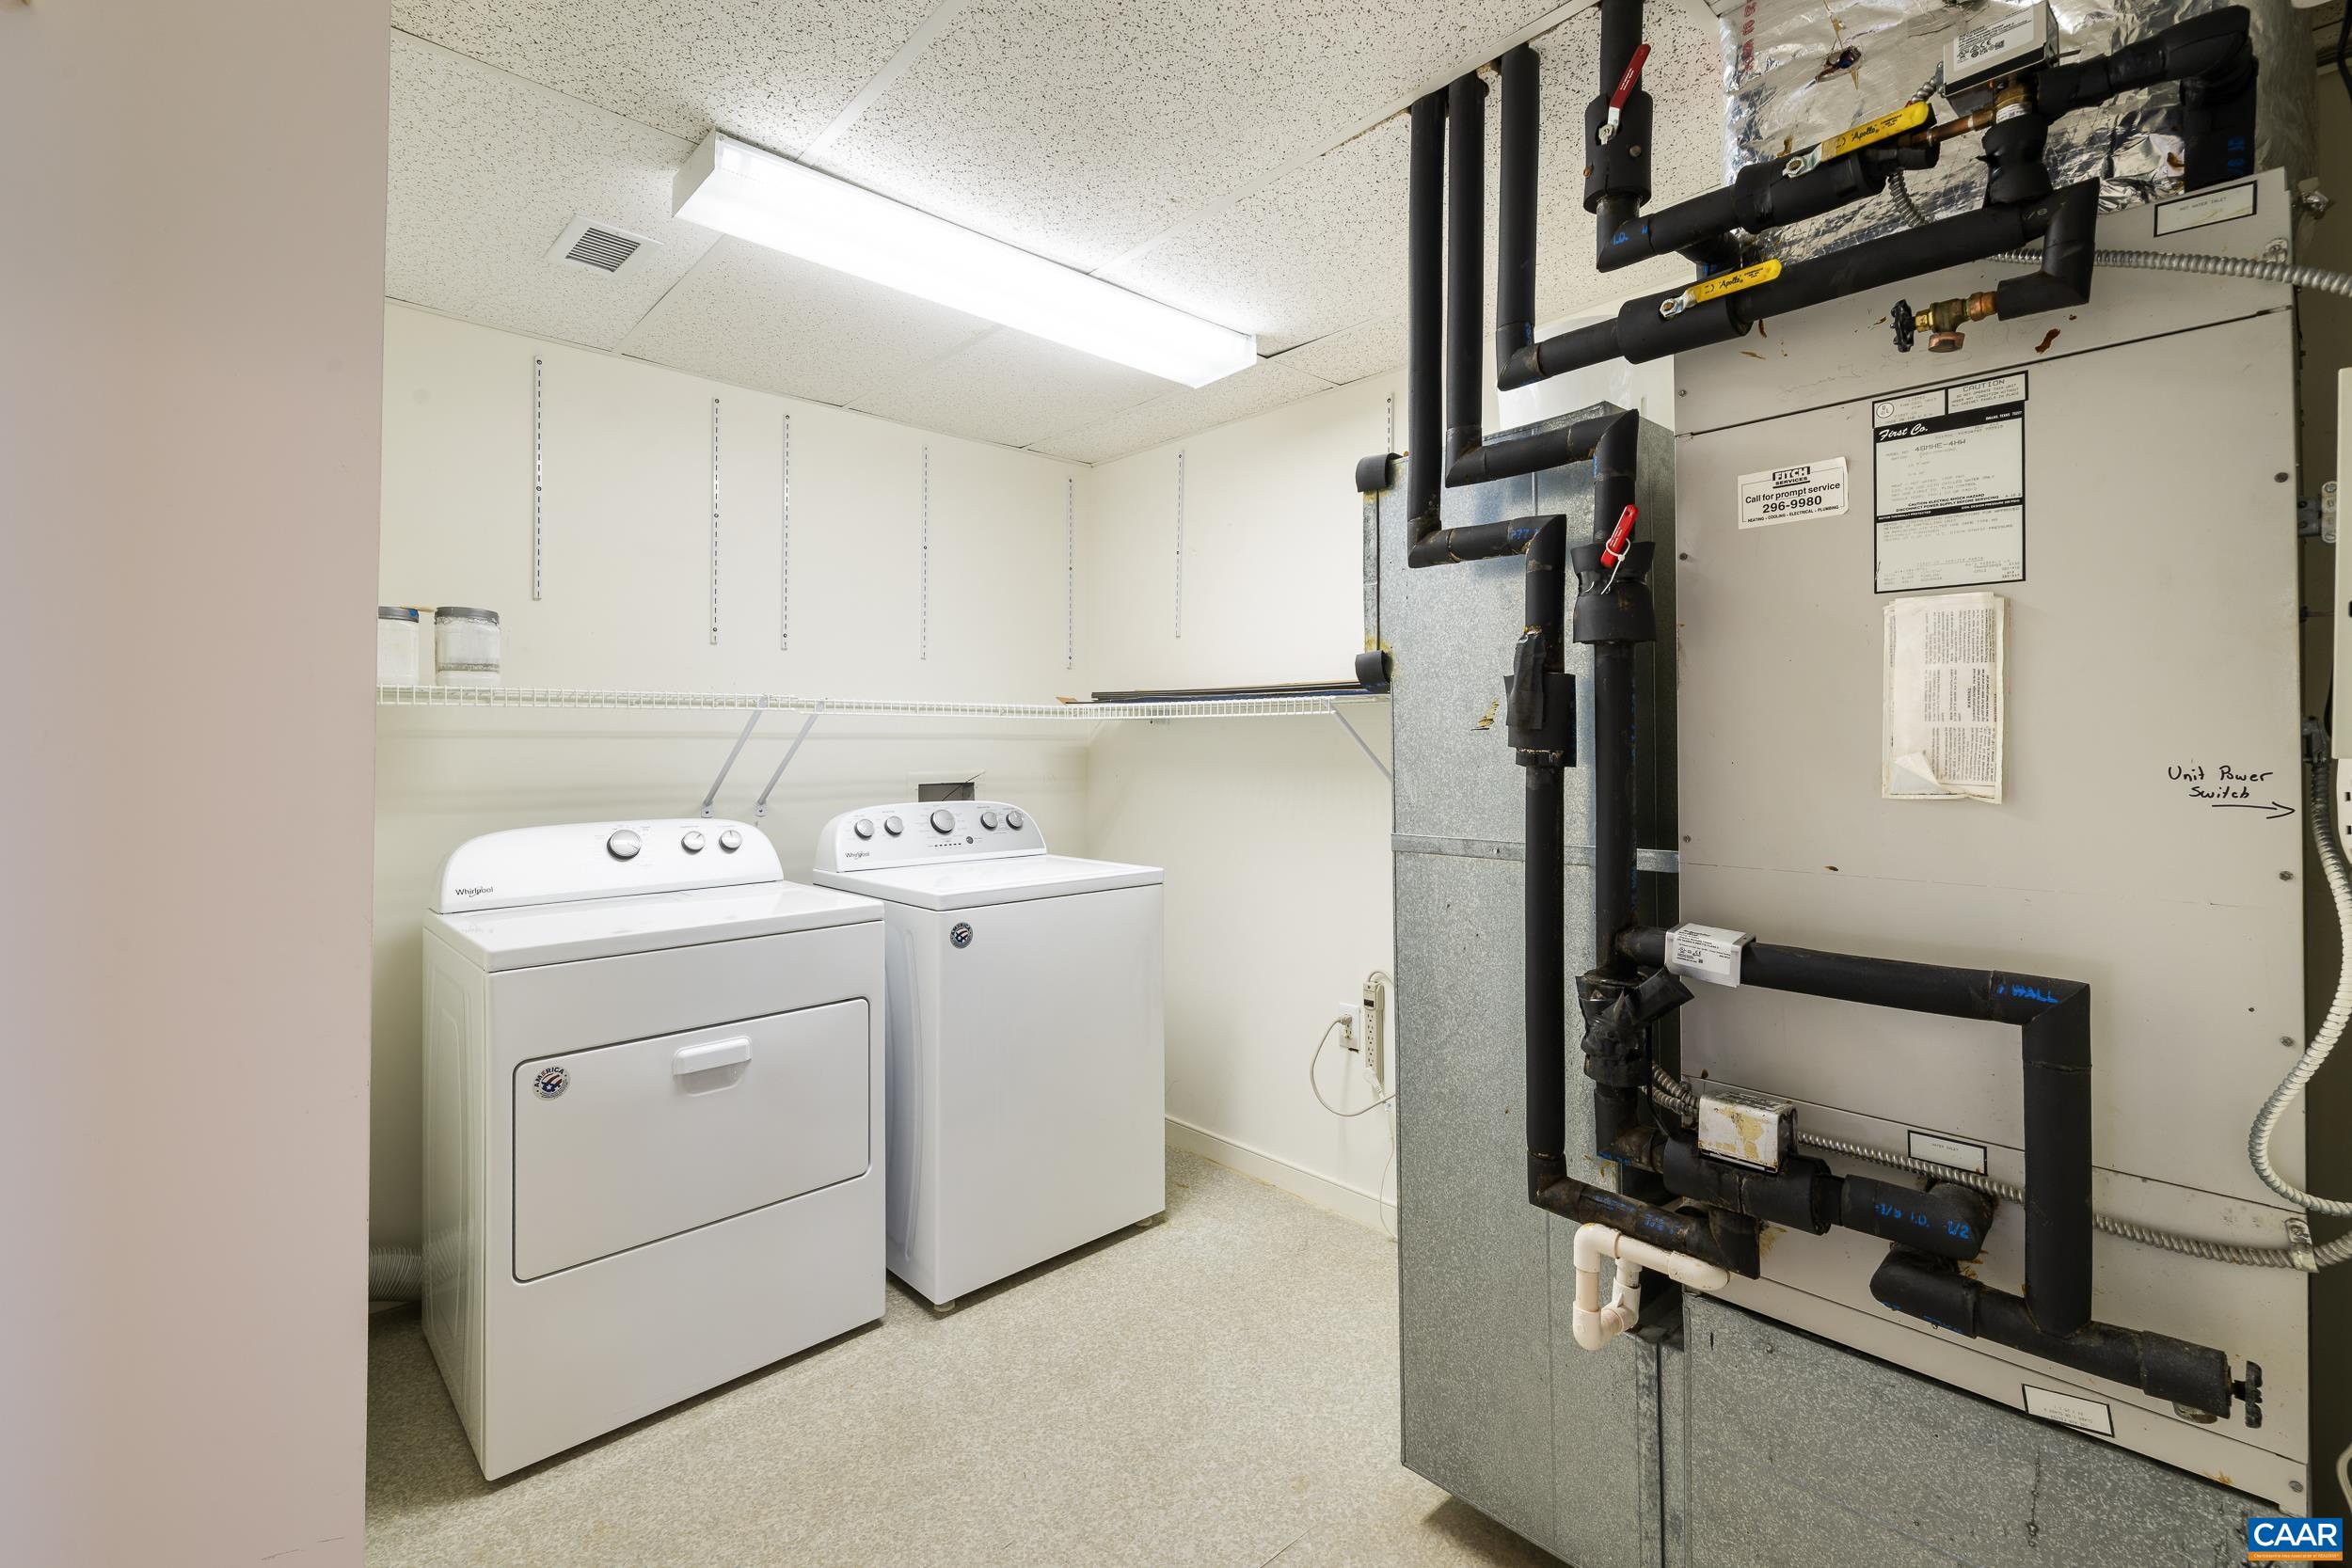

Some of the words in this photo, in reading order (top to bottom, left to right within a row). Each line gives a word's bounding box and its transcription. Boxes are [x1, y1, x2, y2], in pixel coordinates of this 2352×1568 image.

[1963, 378, 2005, 392] CAUTION
[1879, 428, 1908, 441] First
[1911, 423, 1929, 436] Co.
[1772, 466, 1810, 481] FITCH
[1775, 476, 1808, 485] SERVICES
[1745, 494, 1761, 504] Call
[1762, 492, 1774, 501] for
[1775, 487, 1806, 500] prompt
[1808, 483, 1840, 494] service
[1762, 495, 1822, 514] 296-9980
[2168, 765, 2204, 782] Unit
[2219, 765, 2274, 782] Power
[455, 886, 494, 897] Whirlpool
[533, 1067, 564, 1087] AMERICA
